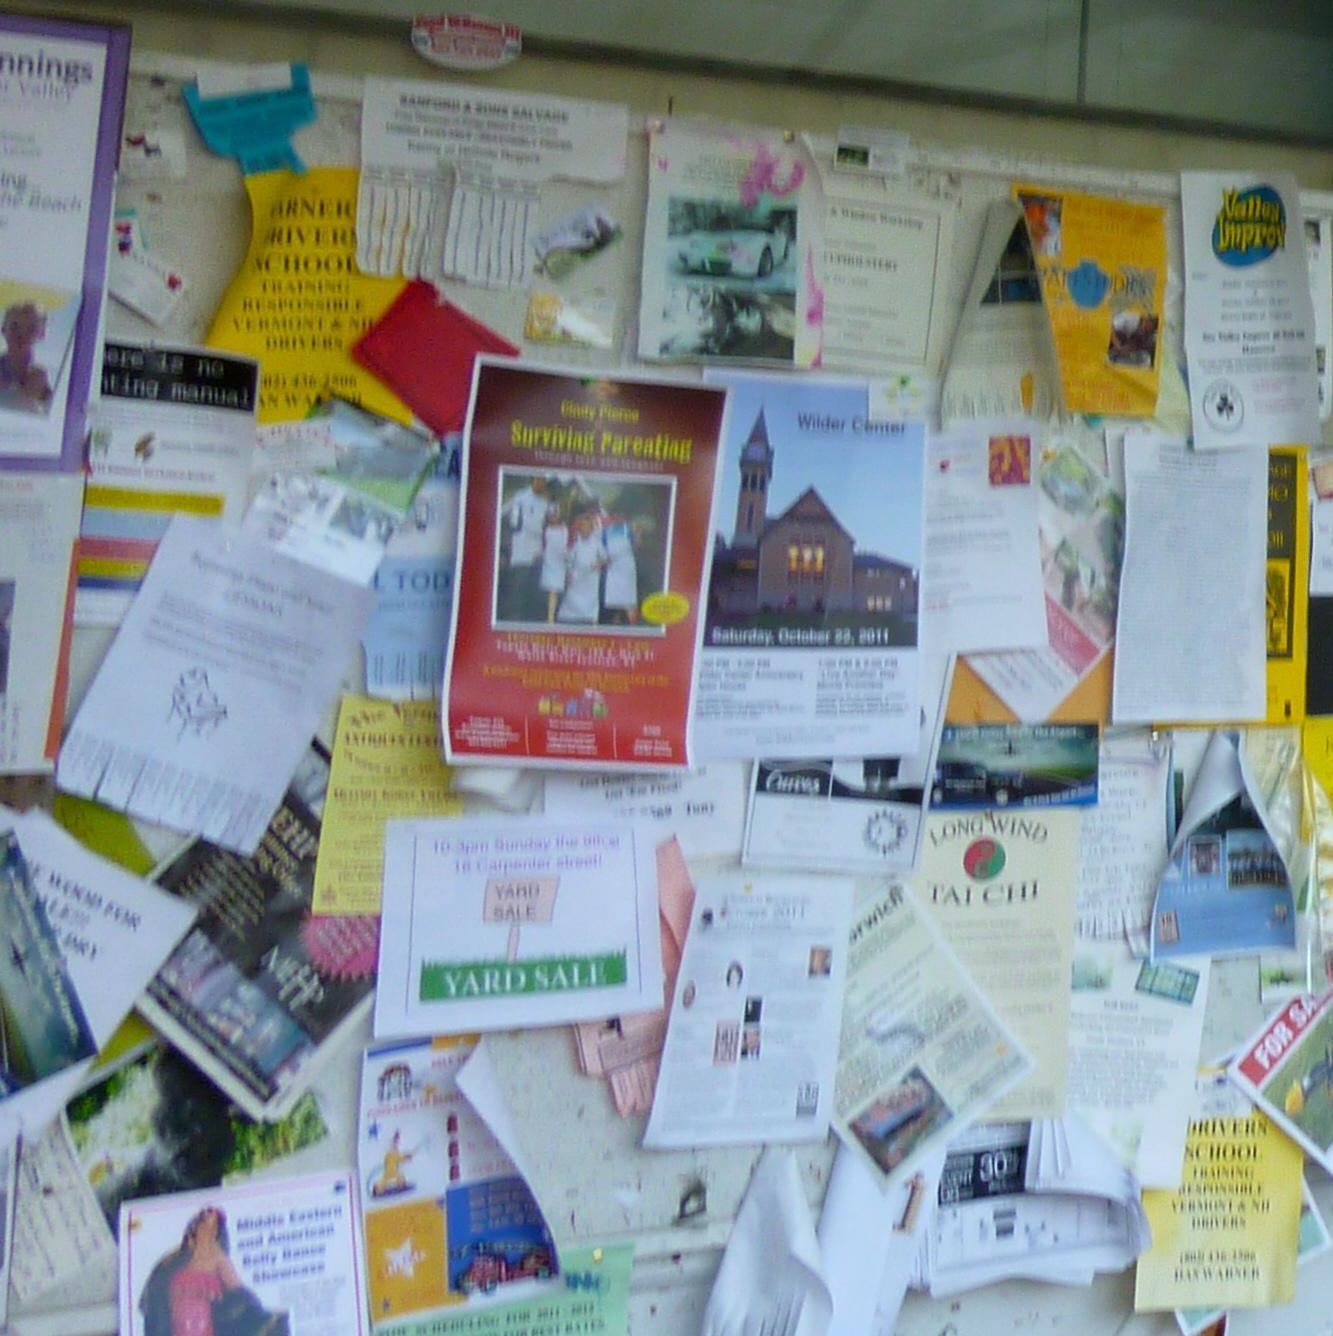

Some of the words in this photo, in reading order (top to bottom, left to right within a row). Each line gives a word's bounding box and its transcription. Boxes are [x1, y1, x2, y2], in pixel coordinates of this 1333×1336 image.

[1223, 185, 1280, 224] Valley
[1217, 215, 1287, 252] Improv
[797, 412, 846, 434] Wilder
[510, 419, 595, 456] Surviving
[600, 430, 692, 464] Parenting
[777, 627, 832, 646] October
[929, 817, 985, 848] LONG
[989, 817, 1049, 843] WIND
[495, 883, 541, 901] YARD
[983, 879, 1039, 906] CHI
[493, 903, 537, 921] SALE
[847, 884, 905, 945] orwich
[443, 967, 526, 997] YARD
[535, 961, 606, 990] SALE
[1254, 1022, 1294, 1071] FOR
[236, 1214, 285, 1232] Middle
[237, 1234, 265, 1250] and
[267, 1223, 335, 1247] American
[252, 1262, 326, 1283] Showcase
